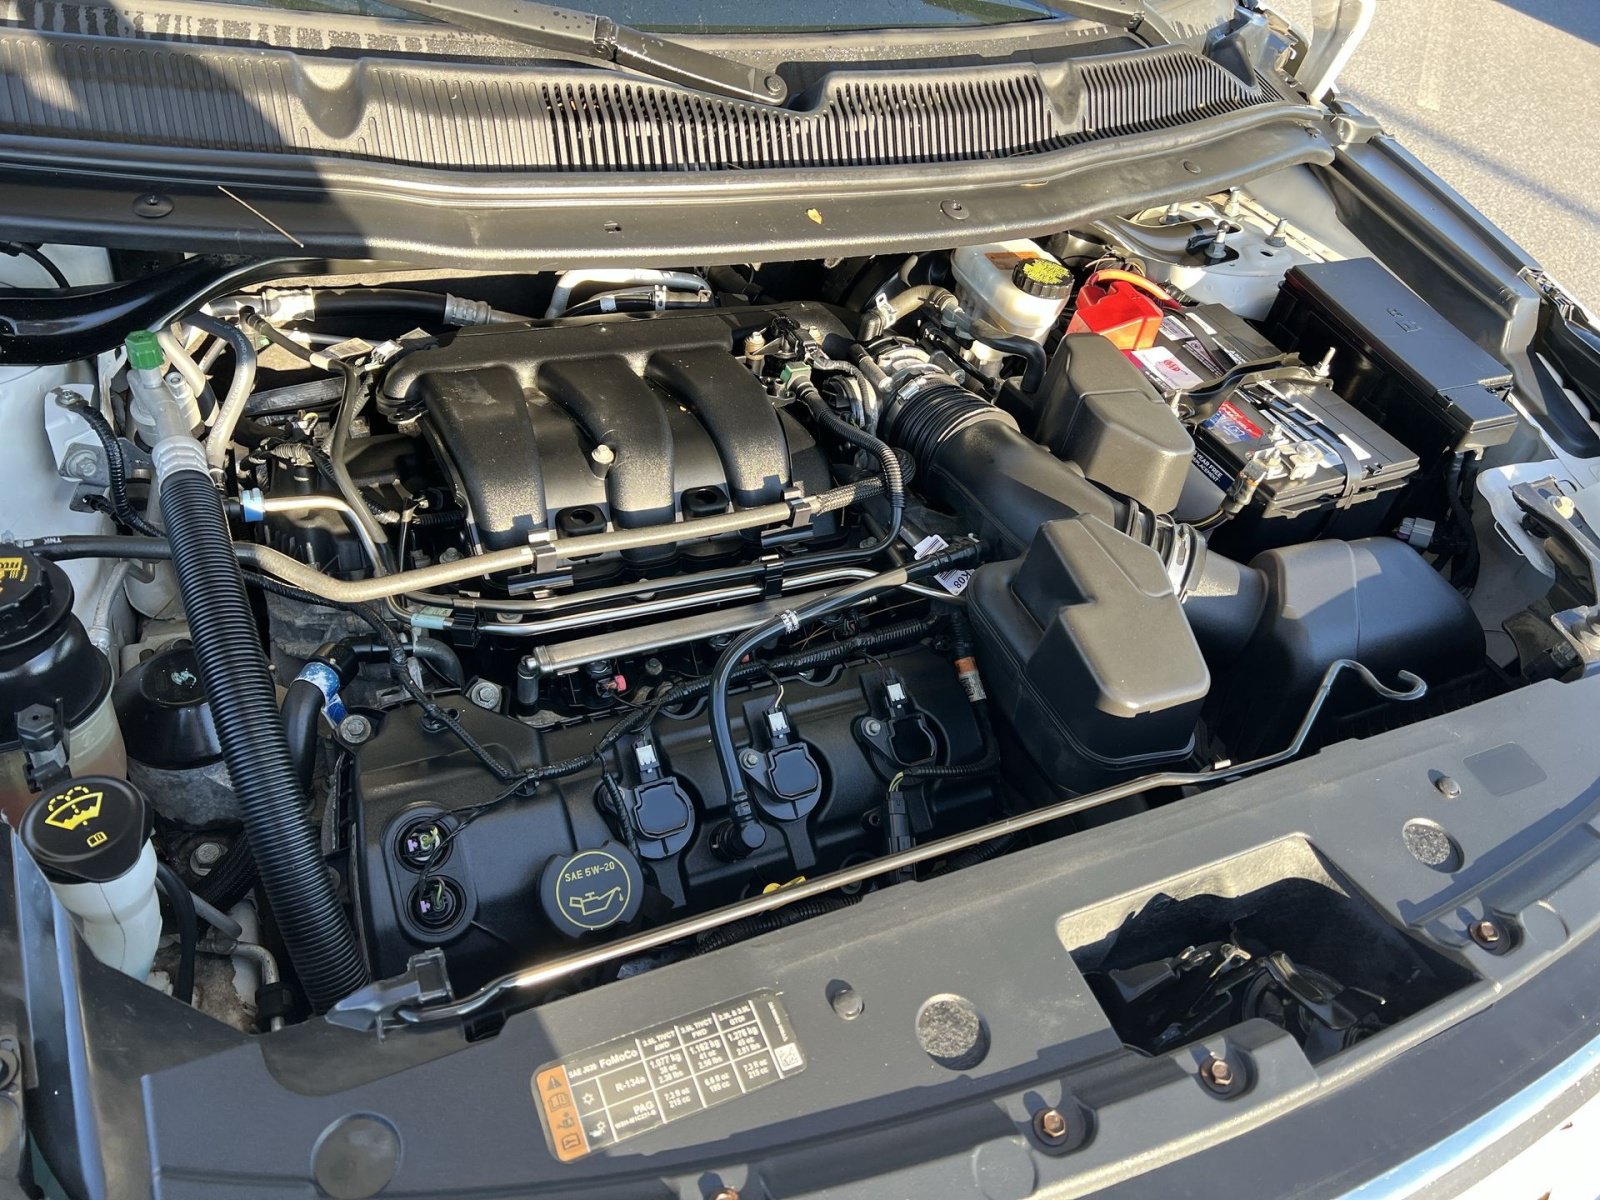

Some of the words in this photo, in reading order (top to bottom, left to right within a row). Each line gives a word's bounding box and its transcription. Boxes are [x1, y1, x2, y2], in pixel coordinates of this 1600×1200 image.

[1192, 457, 1218, 482] EPLACEMENT
[1196, 452, 1210, 467] YEAR
[1208, 464, 1223, 478] FREE
[954, 570, 970, 588] K08
[564, 870, 584, 882] SAE
[585, 862, 614, 876] 5W-20
[746, 1027, 758, 1035] kg
[709, 1039, 721, 1048] kg
[599, 1050, 638, 1068] FoMoCo
[650, 1055, 670, 1069] 1.077
[670, 1053, 682, 1062] kg
[615, 1076, 646, 1092] R-134a
[681, 1087, 690, 1095] oz
[633, 1101, 654, 1115] PAG
